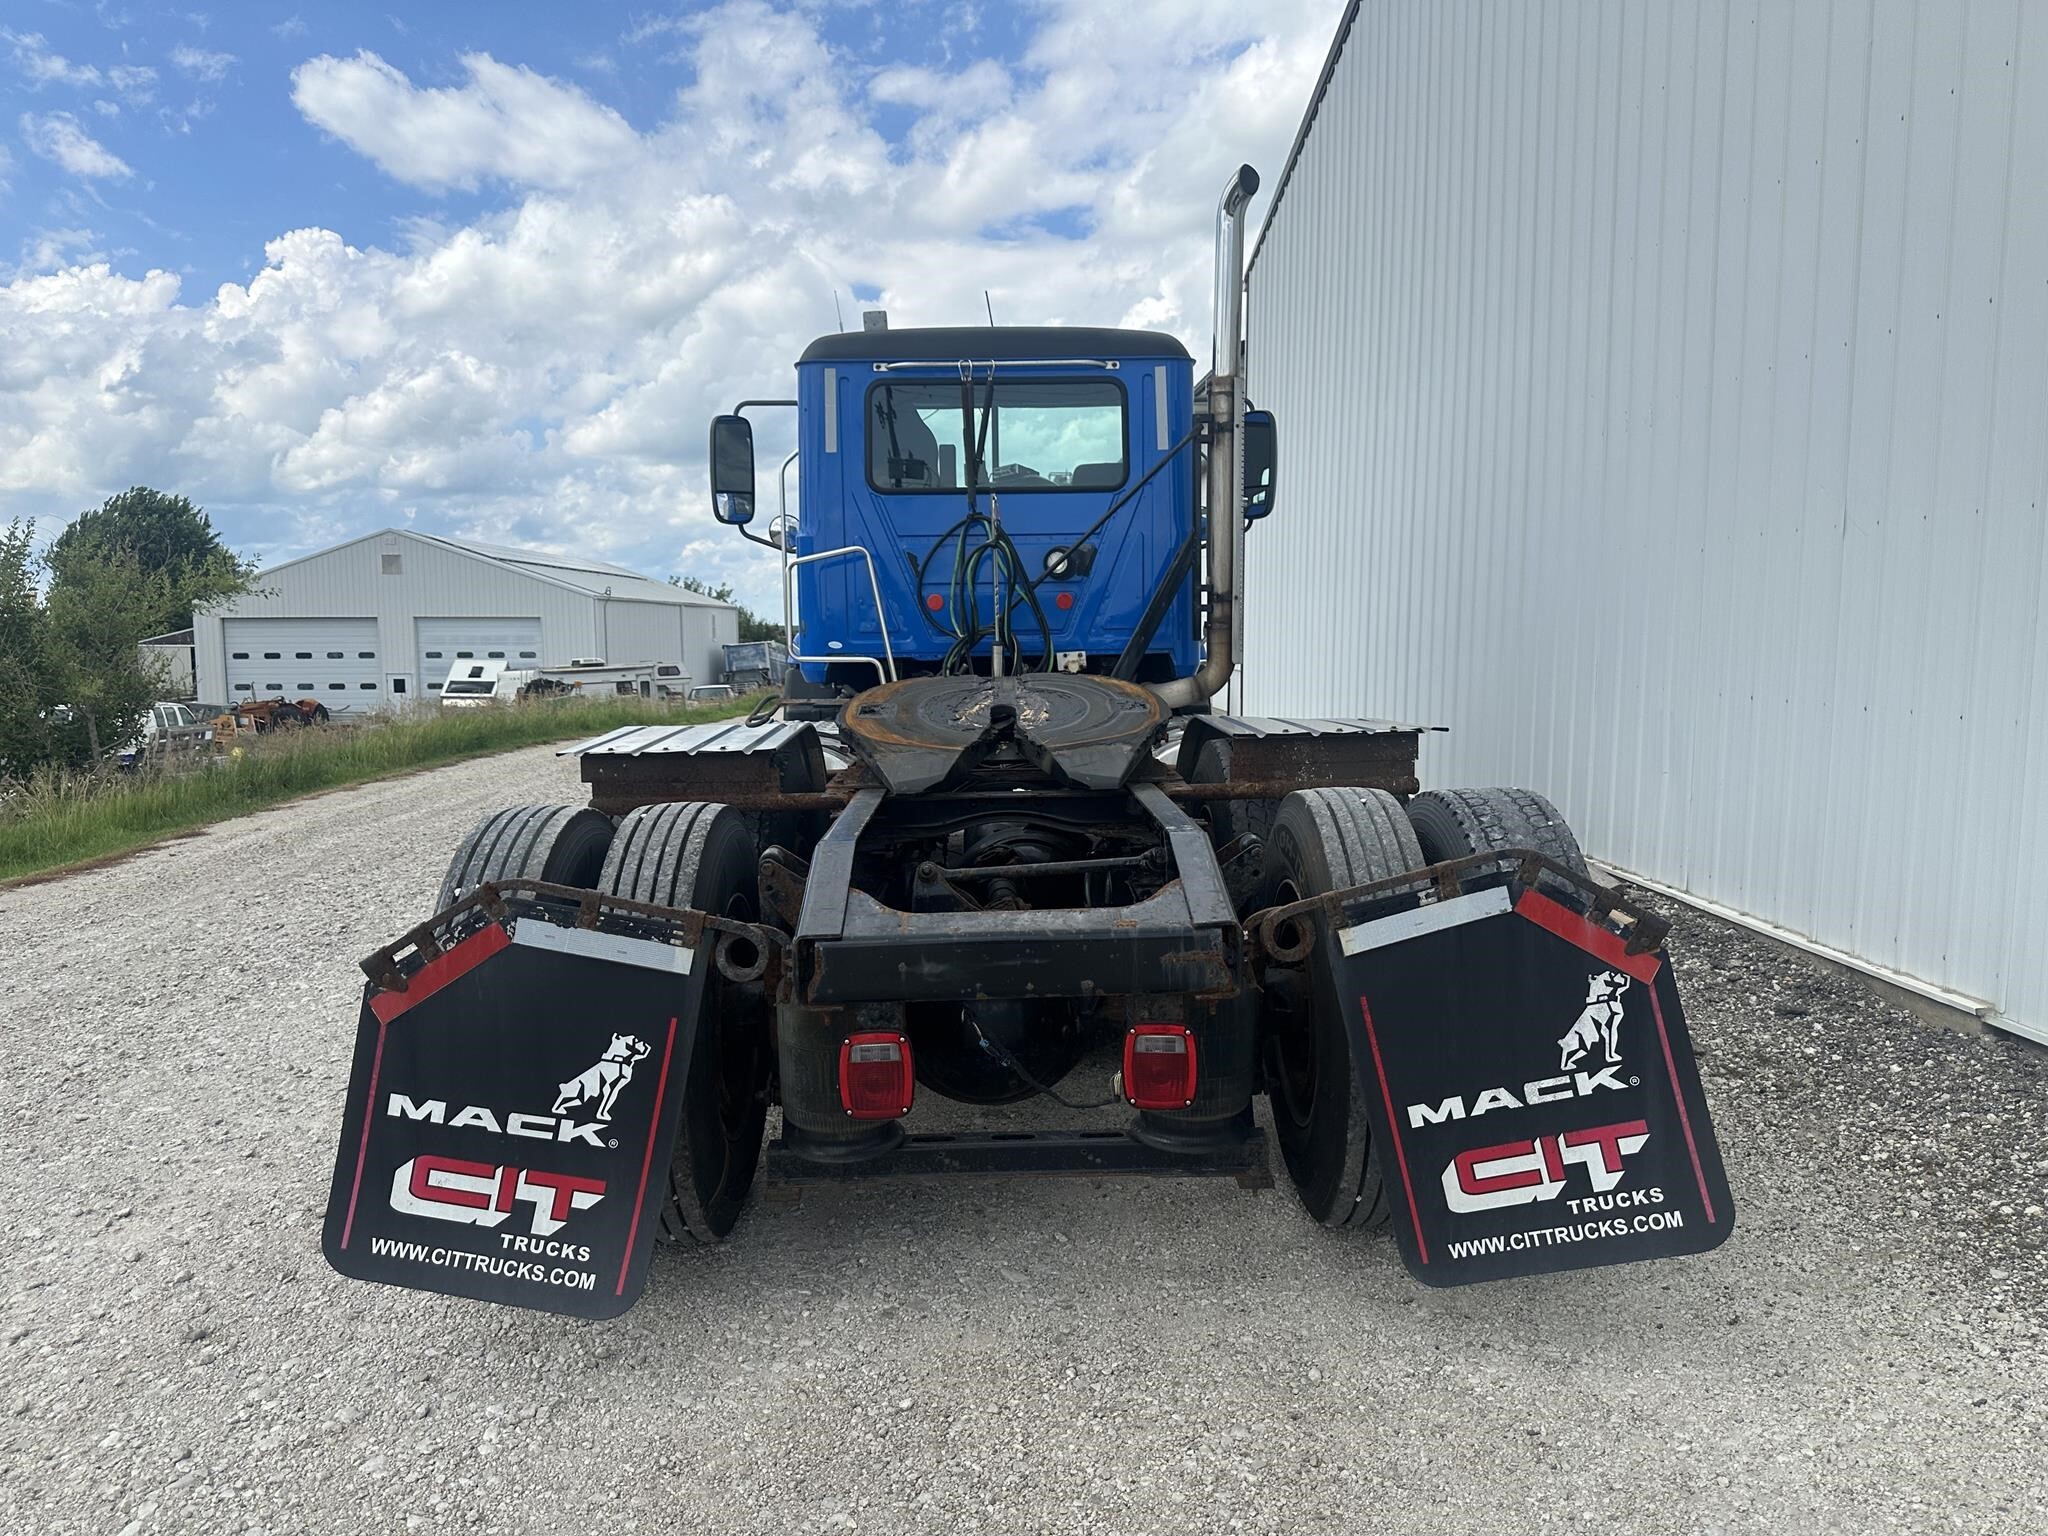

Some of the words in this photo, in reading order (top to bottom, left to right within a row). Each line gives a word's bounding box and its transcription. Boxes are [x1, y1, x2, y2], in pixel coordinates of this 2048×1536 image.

[387, 1093, 609, 1148] MACK
[1407, 1065, 1630, 1129] MACK
[1442, 1119, 1651, 1214] CIT
[390, 1154, 607, 1236] CIT
[1566, 1187, 1665, 1215] TRUCKS
[501, 1233, 591, 1262] TRUCKS
[1447, 1211, 1684, 1259] WWW.CITTRUCKS.COM
[371, 1237, 597, 1291] WWW.CITTRUCKS.COM
